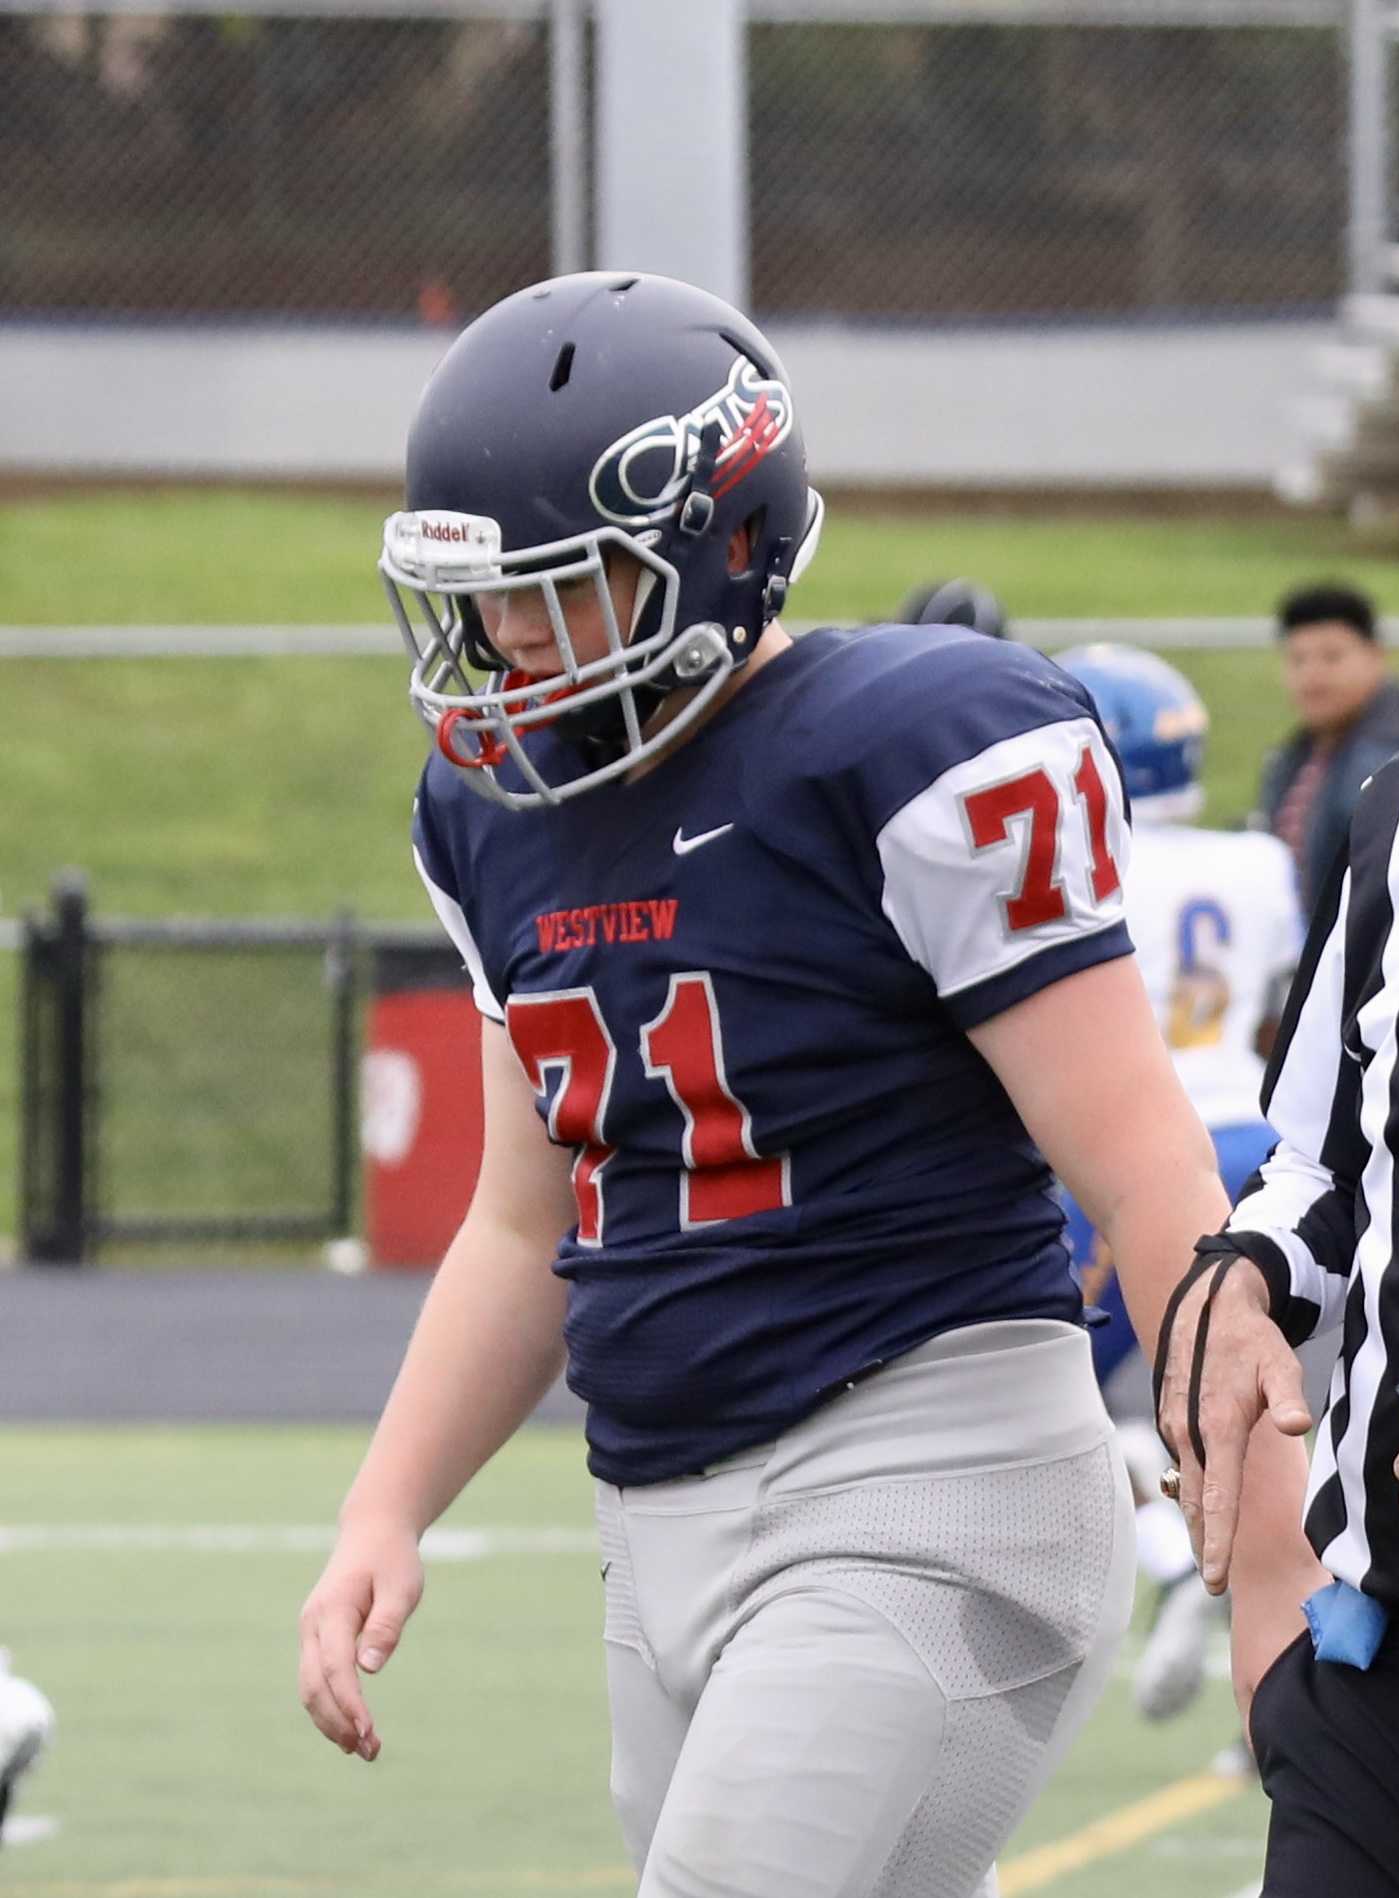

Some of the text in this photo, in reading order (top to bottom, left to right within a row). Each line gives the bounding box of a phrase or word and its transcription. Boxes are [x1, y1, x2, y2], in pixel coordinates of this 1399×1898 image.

[536, 899, 679, 954] WESTVIEW
[955, 740, 1123, 944] 71
[505, 970, 792, 1249] 71
